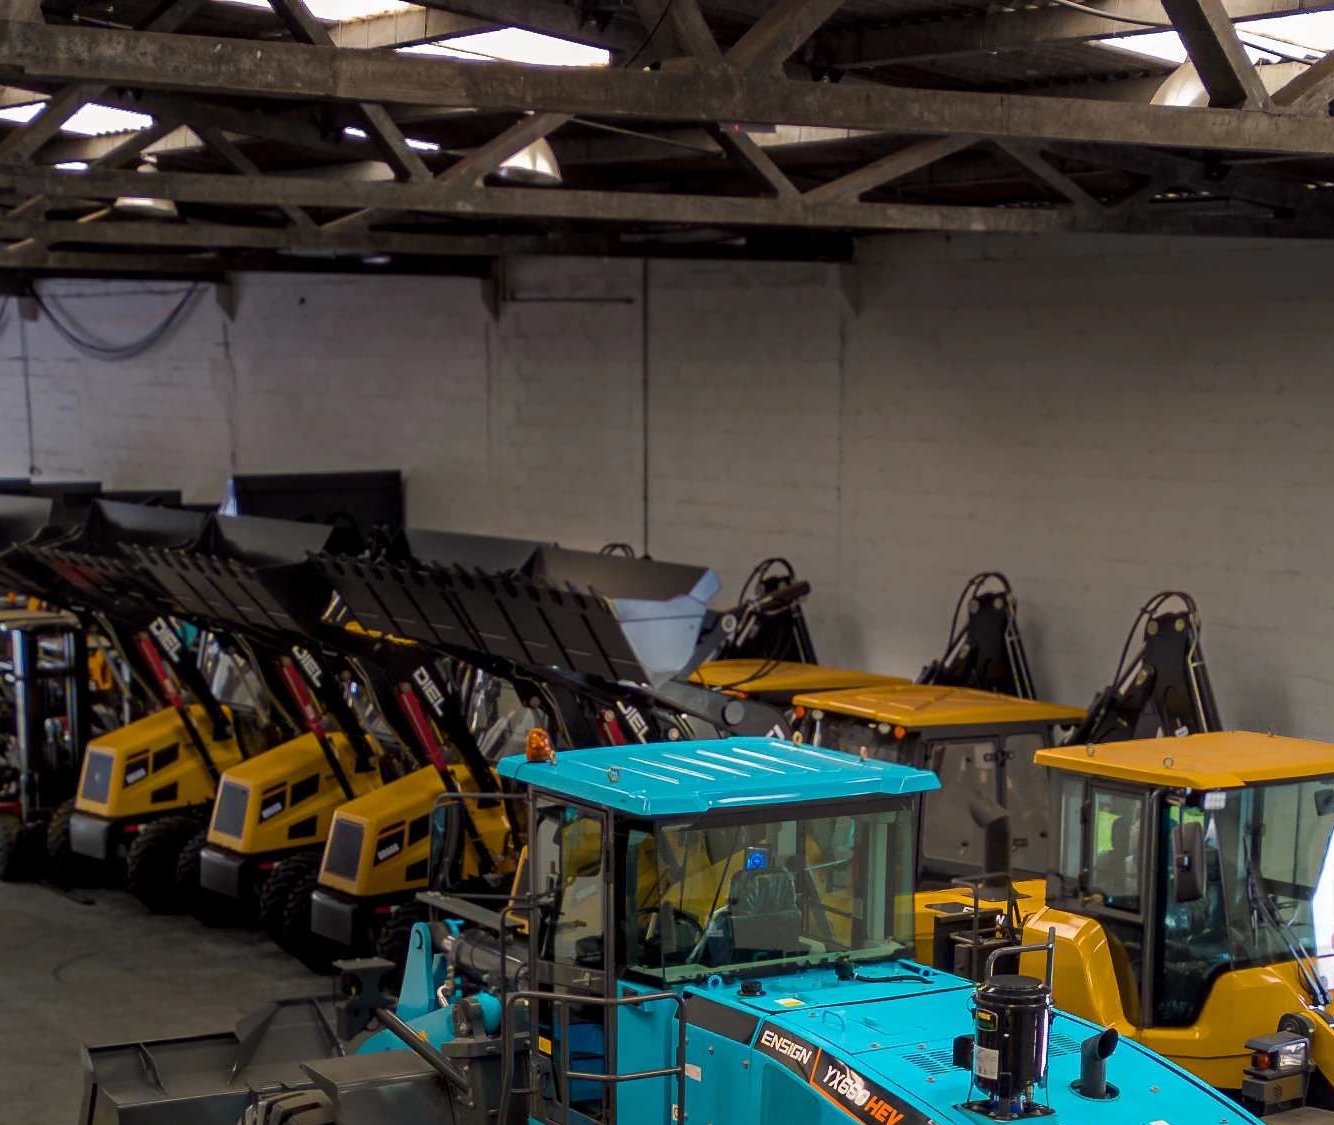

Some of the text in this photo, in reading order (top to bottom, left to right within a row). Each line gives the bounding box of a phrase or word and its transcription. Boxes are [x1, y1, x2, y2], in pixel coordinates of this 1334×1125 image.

[148, 616, 182, 663] DIEL
[413, 666, 445, 717] DIEL
[760, 1030, 813, 1065] ENSIGN
